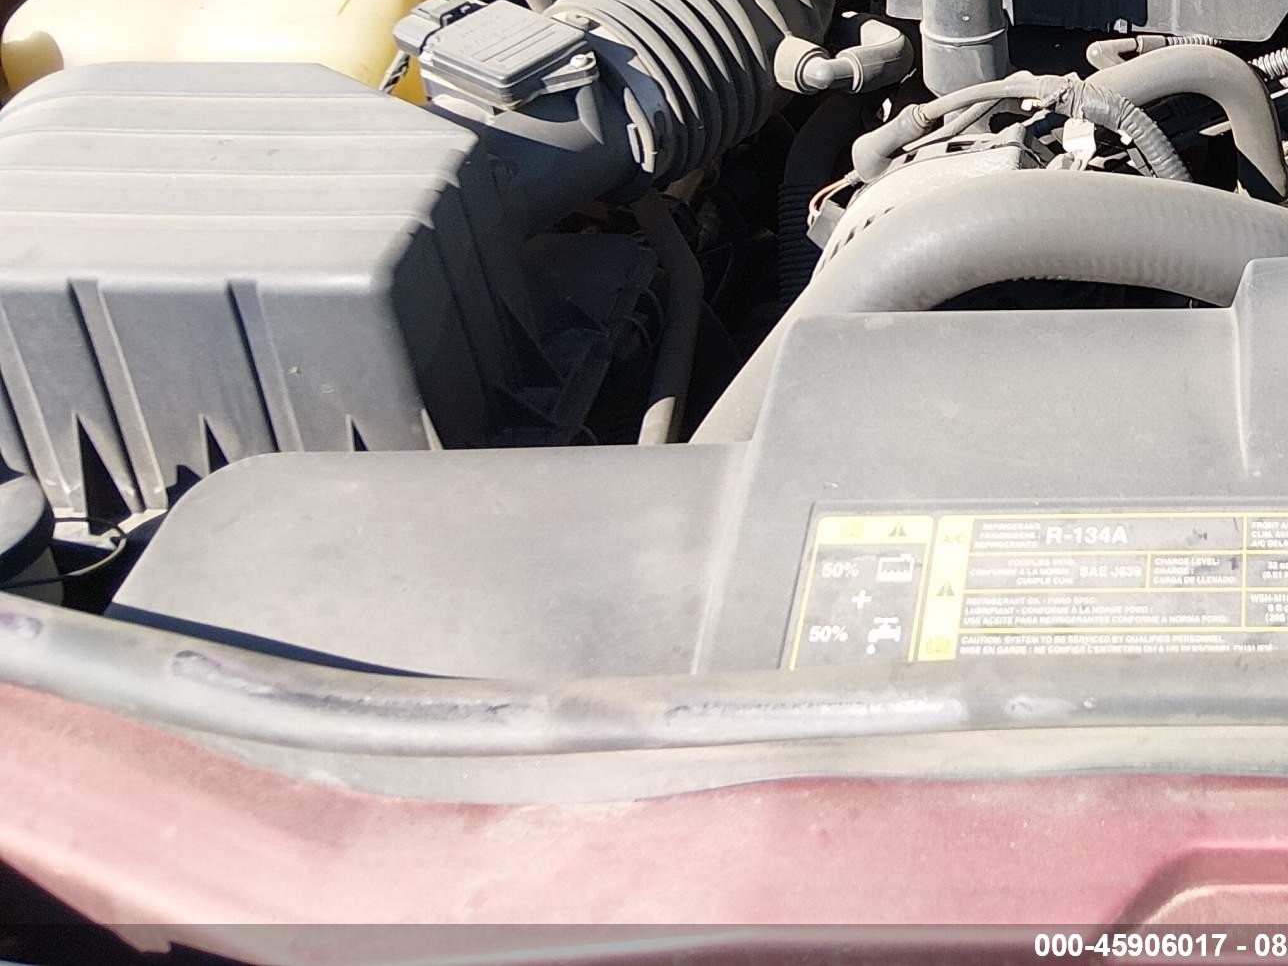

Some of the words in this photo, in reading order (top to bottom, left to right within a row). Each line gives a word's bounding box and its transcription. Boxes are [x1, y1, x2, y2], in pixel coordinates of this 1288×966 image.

[1045, 526, 1129, 545] R-134A
[821, 561, 860, 578] 50%
[1079, 565, 1107, 578] SAE
[1109, 565, 1142, 578] J639
[808, 625, 850, 642] 50%
